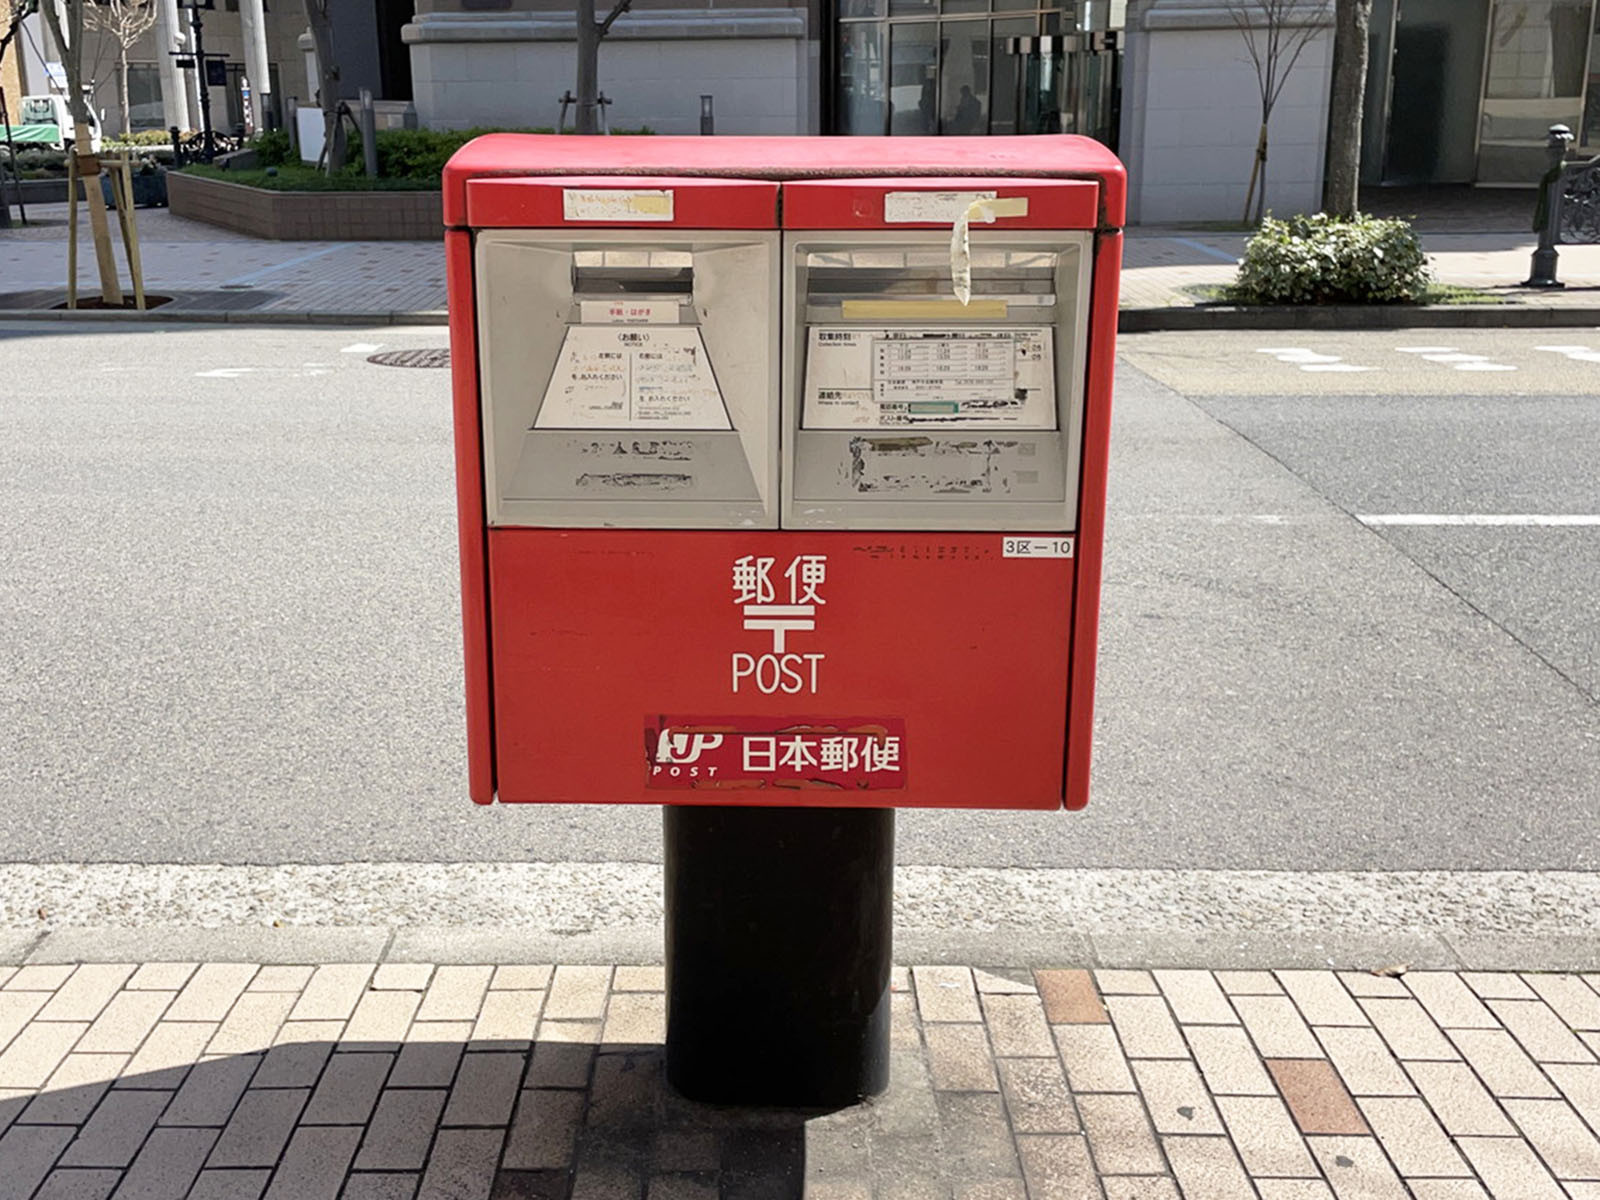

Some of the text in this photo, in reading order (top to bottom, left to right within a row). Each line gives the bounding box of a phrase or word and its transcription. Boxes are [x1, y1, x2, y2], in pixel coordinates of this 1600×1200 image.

[732, 555, 827, 605] 郵便
[732, 654, 825, 694] POST
[652, 766, 718, 777] POST
[742, 736, 900, 773] 日本郵便
